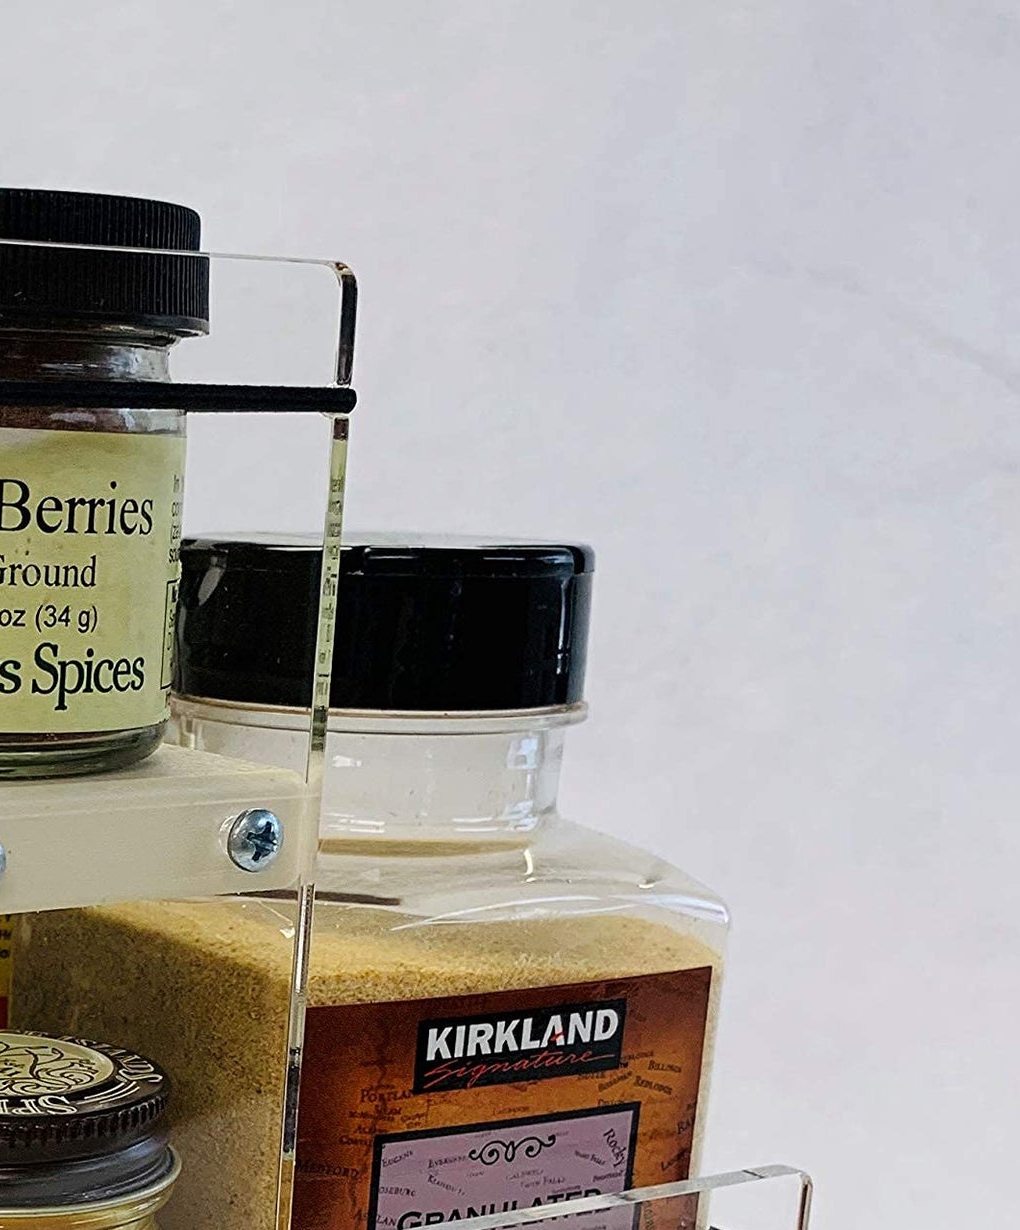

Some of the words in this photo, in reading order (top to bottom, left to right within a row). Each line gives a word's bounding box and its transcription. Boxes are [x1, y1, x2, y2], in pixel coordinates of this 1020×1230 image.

[34, 603, 72, 632] (34
[77, 605, 99, 634] g)
[31, 641, 145, 712] Spices
[426, 1008, 620, 1061] KIRKLAND
[423, 1050, 615, 1089] Signature
[602, 1128, 627, 1168] Rocky
